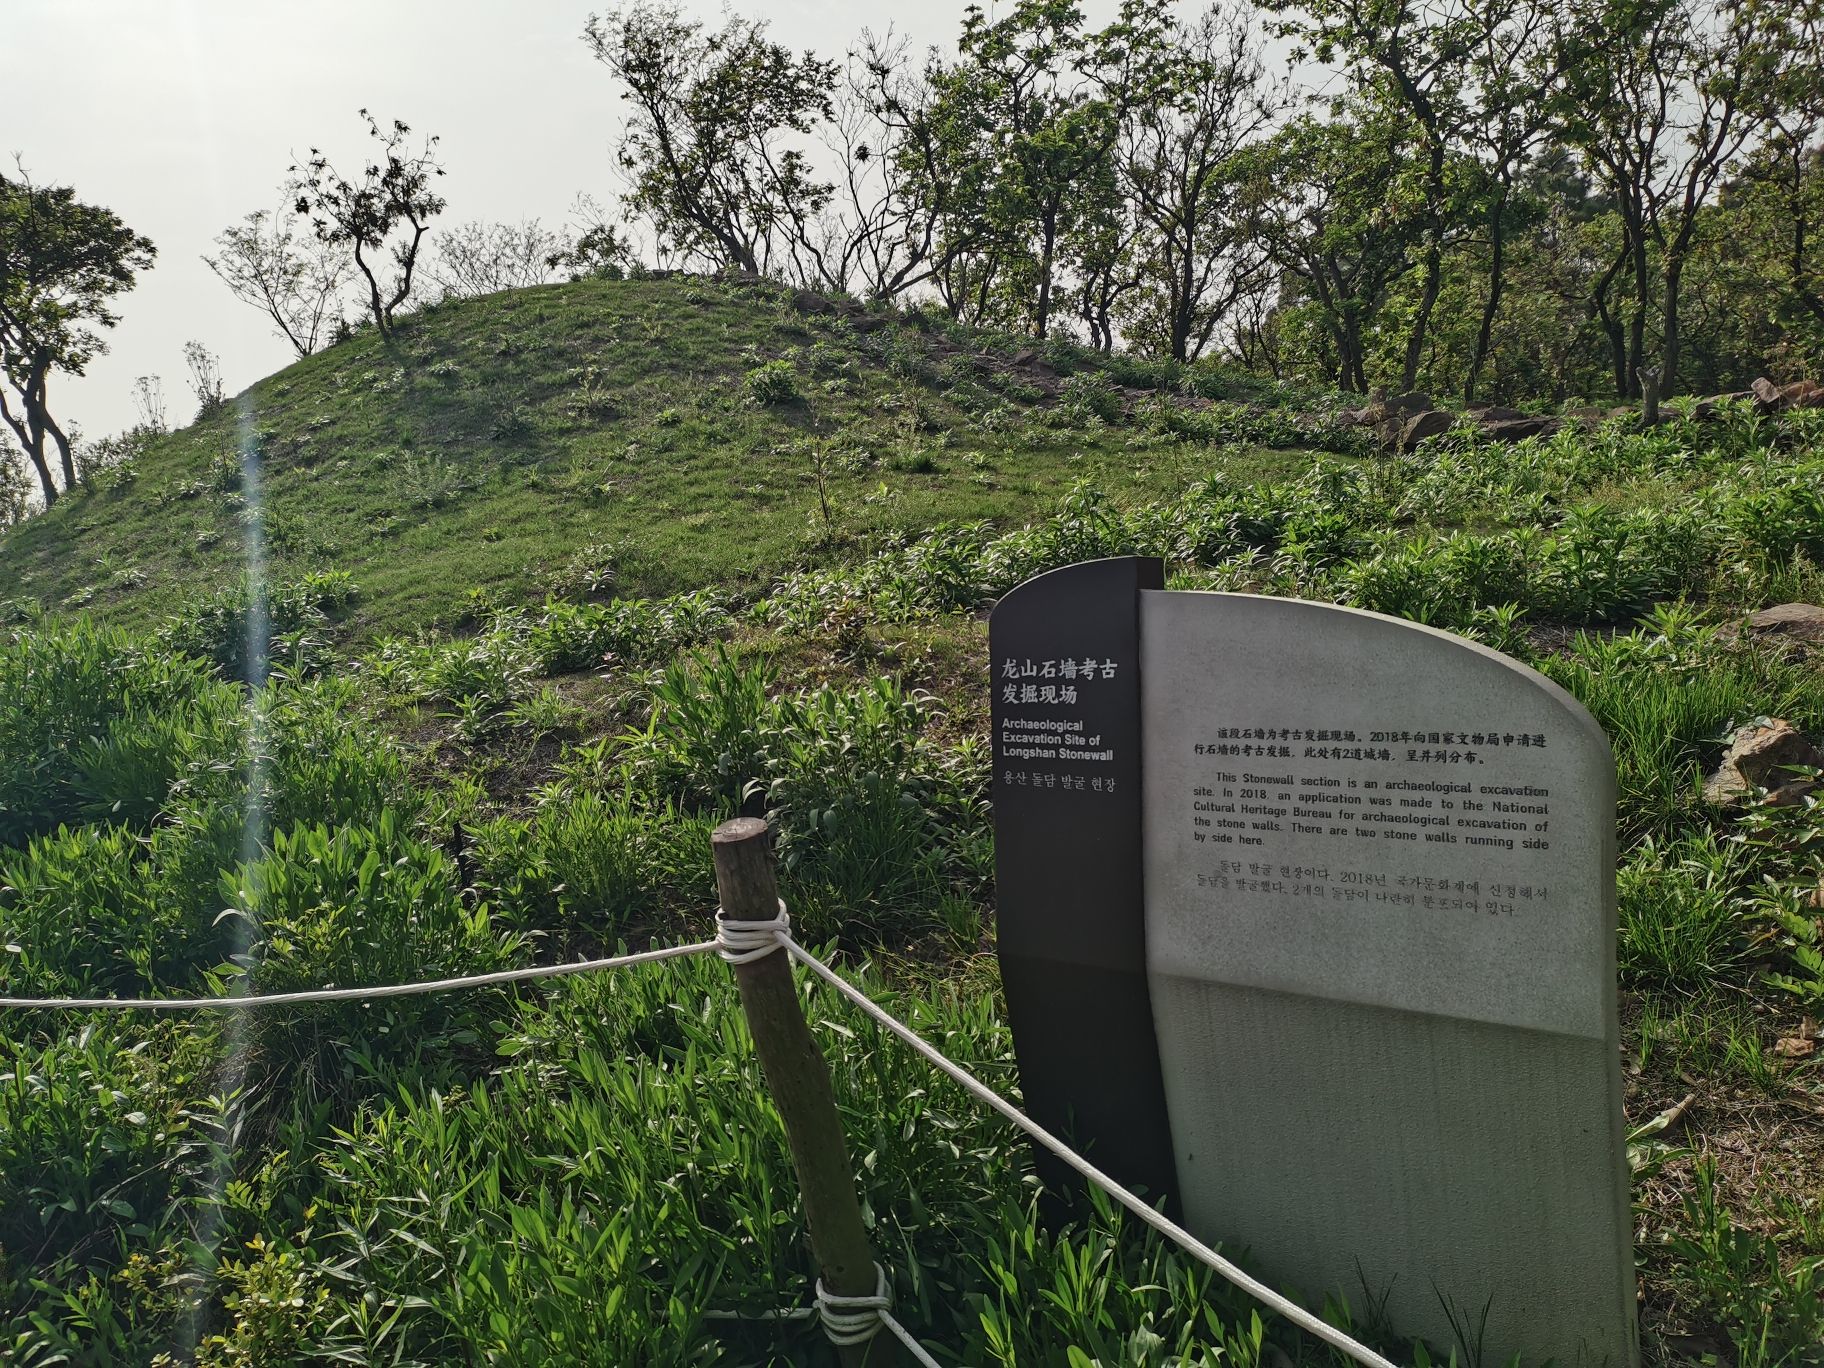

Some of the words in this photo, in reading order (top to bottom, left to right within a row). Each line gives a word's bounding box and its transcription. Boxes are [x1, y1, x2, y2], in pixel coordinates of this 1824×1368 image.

[1001, 658, 1118, 680] 龙山石墙考古
[1002, 683, 1077, 704] 发掘现场
[1002, 718, 1083, 733] Archaeological
[1003, 732, 1061, 744] Excavation
[1065, 735, 1085, 745] Site
[1089, 735, 1100, 745] of
[1003, 746, 1055, 759] Longshan
[1059, 748, 1113, 761] Stonewall
[1004, 771, 1028, 785] 용산
[1032, 773, 1056, 788] 돌담
[1061, 775, 1085, 789] 발굴
[1091, 777, 1116, 792] 현장
[1216, 772, 1237, 782] This
[1243, 774, 1294, 785] Stonewall
[1301, 777, 1340, 787] section
[1347, 778, 1357, 788] is
[1364, 780, 1378, 789] an
[1385, 780, 1471, 794] archaeological
[1480, 786, 1549, 796] excavation
[1193, 787, 1215, 796] site.
[1223, 788, 1233, 798] In
[1278, 792, 1291, 800] an
[1298, 793, 1361, 804] application
[1370, 798, 1392, 806] was
[1400, 797, 1432, 808] made
[1441, 799, 1453, 809] to
[1463, 800, 1483, 811] the
[1493, 801, 1548, 814] National
[1194, 802, 1235, 813] Cultural
[1241, 805, 1287, 817] Heritage
[1294, 807, 1332, 819] Bureau
[1339, 810, 1354, 820] for
[1362, 813, 1450, 827] archaeological
[1458, 819, 1526, 831] excavation
[1535, 821, 1549, 832] of
[1194, 817, 1211, 826] the
[1217, 818, 1245, 828] stone
[1252, 820, 1283, 831] walls.
[1292, 823, 1322, 834] There
[1330, 826, 1347, 835] are
[1356, 827, 1376, 837] two
[1384, 829, 1417, 840] stone
[1425, 832, 1457, 843] walls
[1465, 835, 1513, 849] running
[1523, 838, 1549, 850] side
[1194, 832, 1205, 842] by
[1212, 833, 1232, 843] side
[1239, 834, 1265, 845] here.
[1220, 860, 1241, 873] 돌담
[1249, 863, 1272, 876] 발굴
[1279, 865, 1333, 881] 현장이다.
[1340, 872, 1386, 886] 2018년
[1293, 884, 1324, 897] 2개의
[1332, 887, 1368, 901] 돌담이
